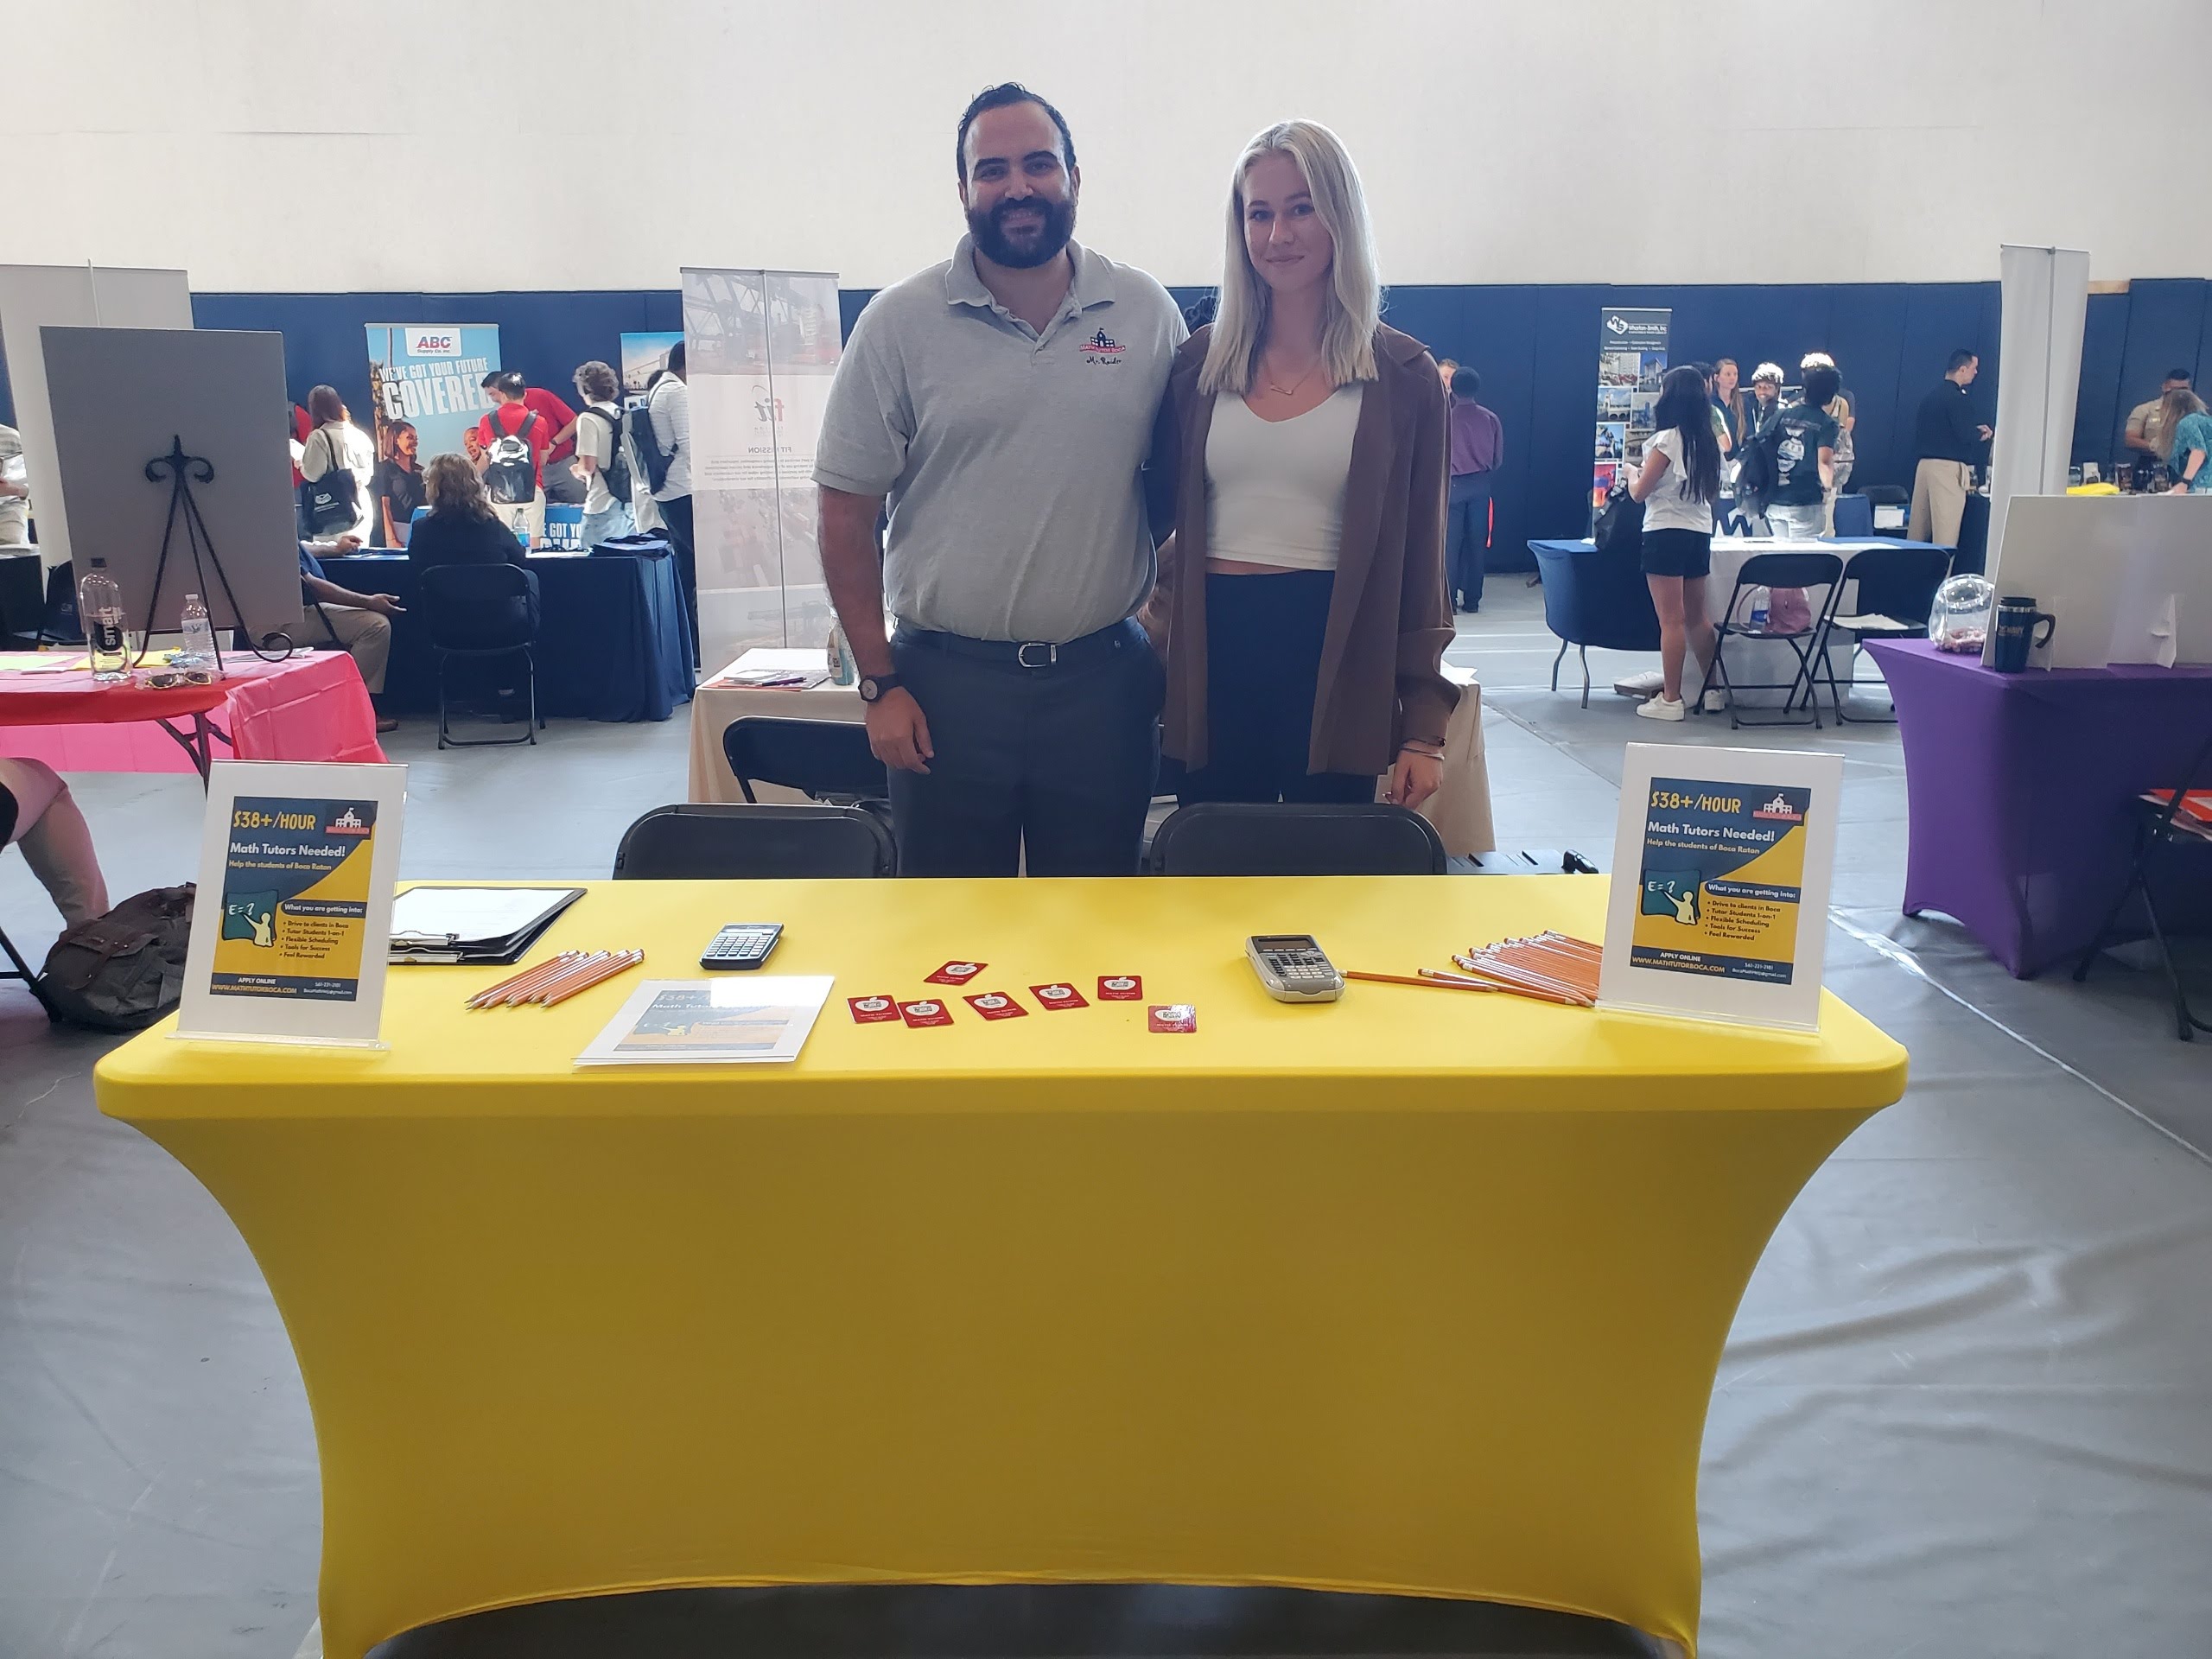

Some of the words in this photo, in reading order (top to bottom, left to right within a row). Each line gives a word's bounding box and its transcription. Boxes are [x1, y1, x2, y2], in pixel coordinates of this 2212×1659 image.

[416, 336, 452, 348] ABC
[379, 365, 408, 382] WE'VE
[410, 364, 427, 378] GOT
[429, 360, 454, 377] YOUR
[456, 358, 488, 373] FUTURE
[550, 523, 568, 537] GOT
[99, 607, 116, 646] smart
[1650, 791, 1741, 814] $38+/HOUR
[233, 810, 316, 830] $38+/HOUR
[1648, 821, 1679, 834] Math
[1681, 824, 1720, 837] Tutors
[1723, 827, 1775, 842] Needed!
[230, 842, 259, 854] Math
[262, 843, 296, 855] Tutors
[298, 845, 346, 857] Needed!
[1647, 838, 1663, 848] Help
[1678, 841, 1707, 850] students
[228, 860, 244, 868] Help
[1727, 886, 1740, 894] you
[1754, 887, 1778, 898] getting
[1780, 890, 1796, 899] into:
[302, 905, 314, 913] you
[326, 905, 348, 914] getting
[1736, 918, 1770, 927] Scheduling
[1723, 932, 1754, 941] Rewarded
